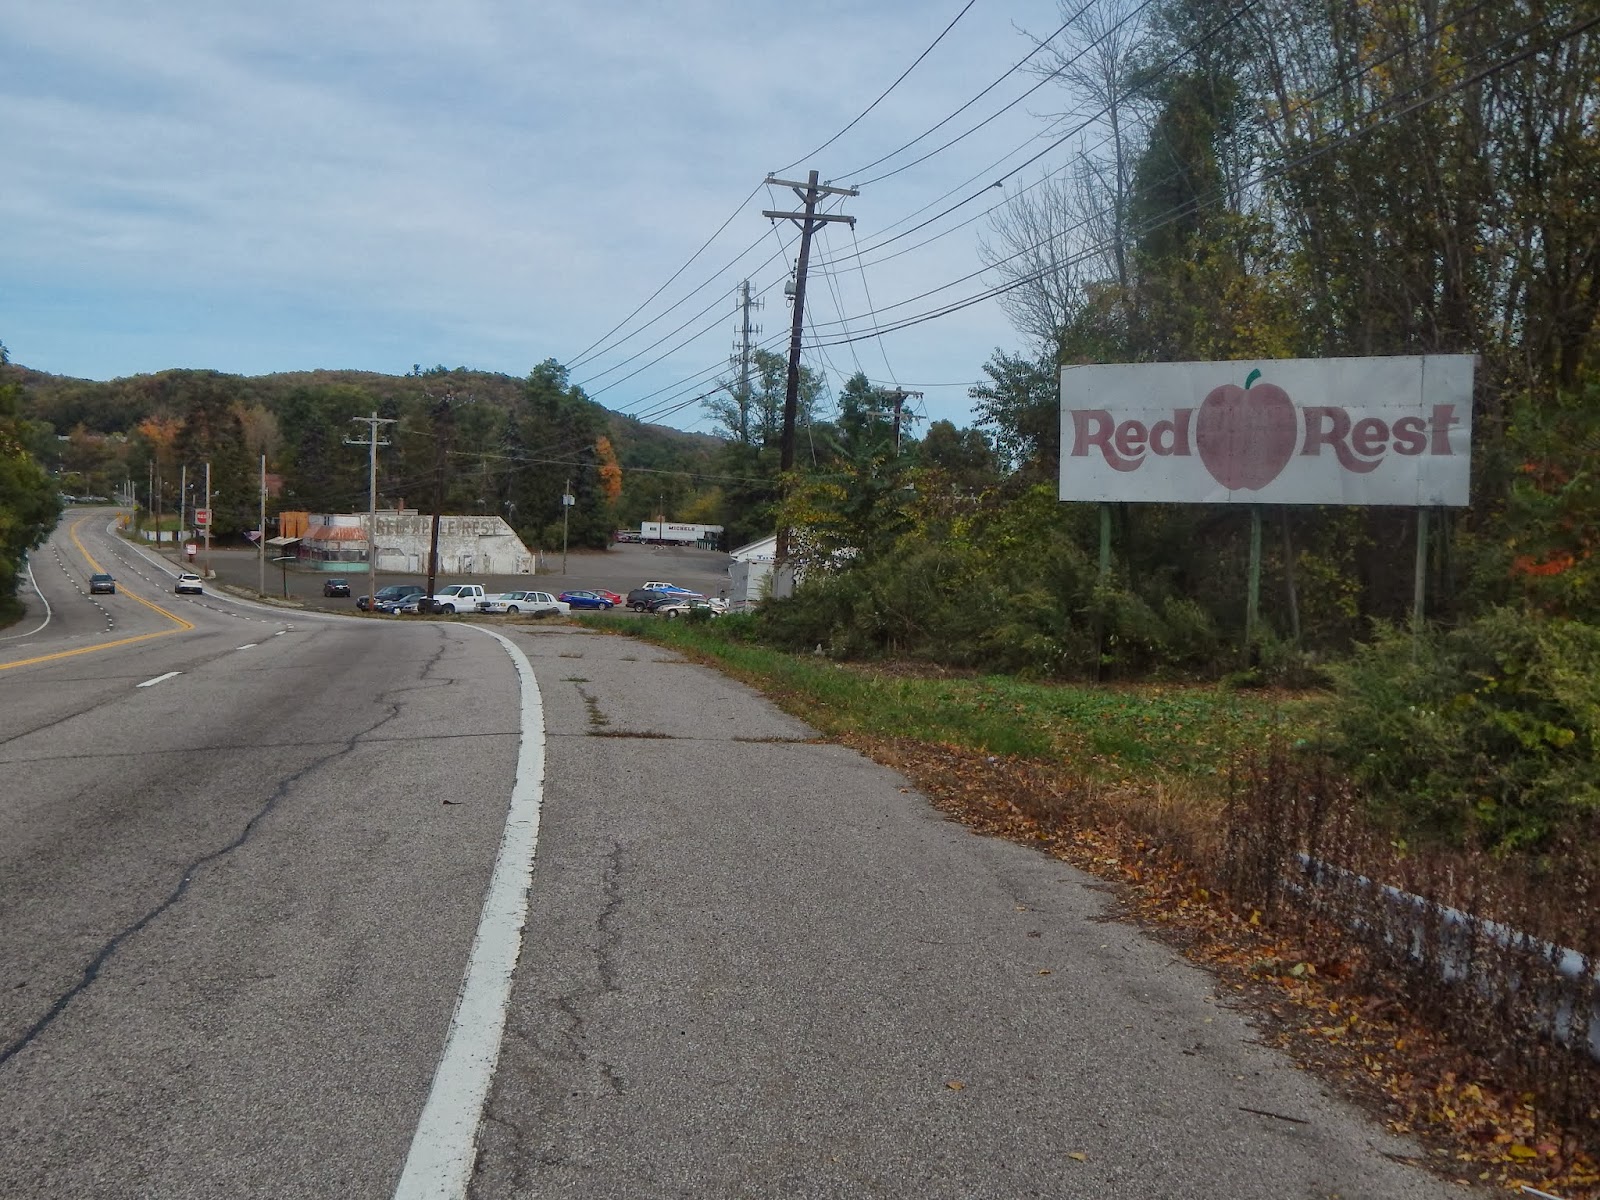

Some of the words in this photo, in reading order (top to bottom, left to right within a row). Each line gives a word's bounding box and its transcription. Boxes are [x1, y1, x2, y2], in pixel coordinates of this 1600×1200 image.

[1071, 408, 1193, 472] Red
[1301, 404, 1460, 474] Rest
[412, 520, 455, 535] APLE
[462, 520, 500, 535] REST
